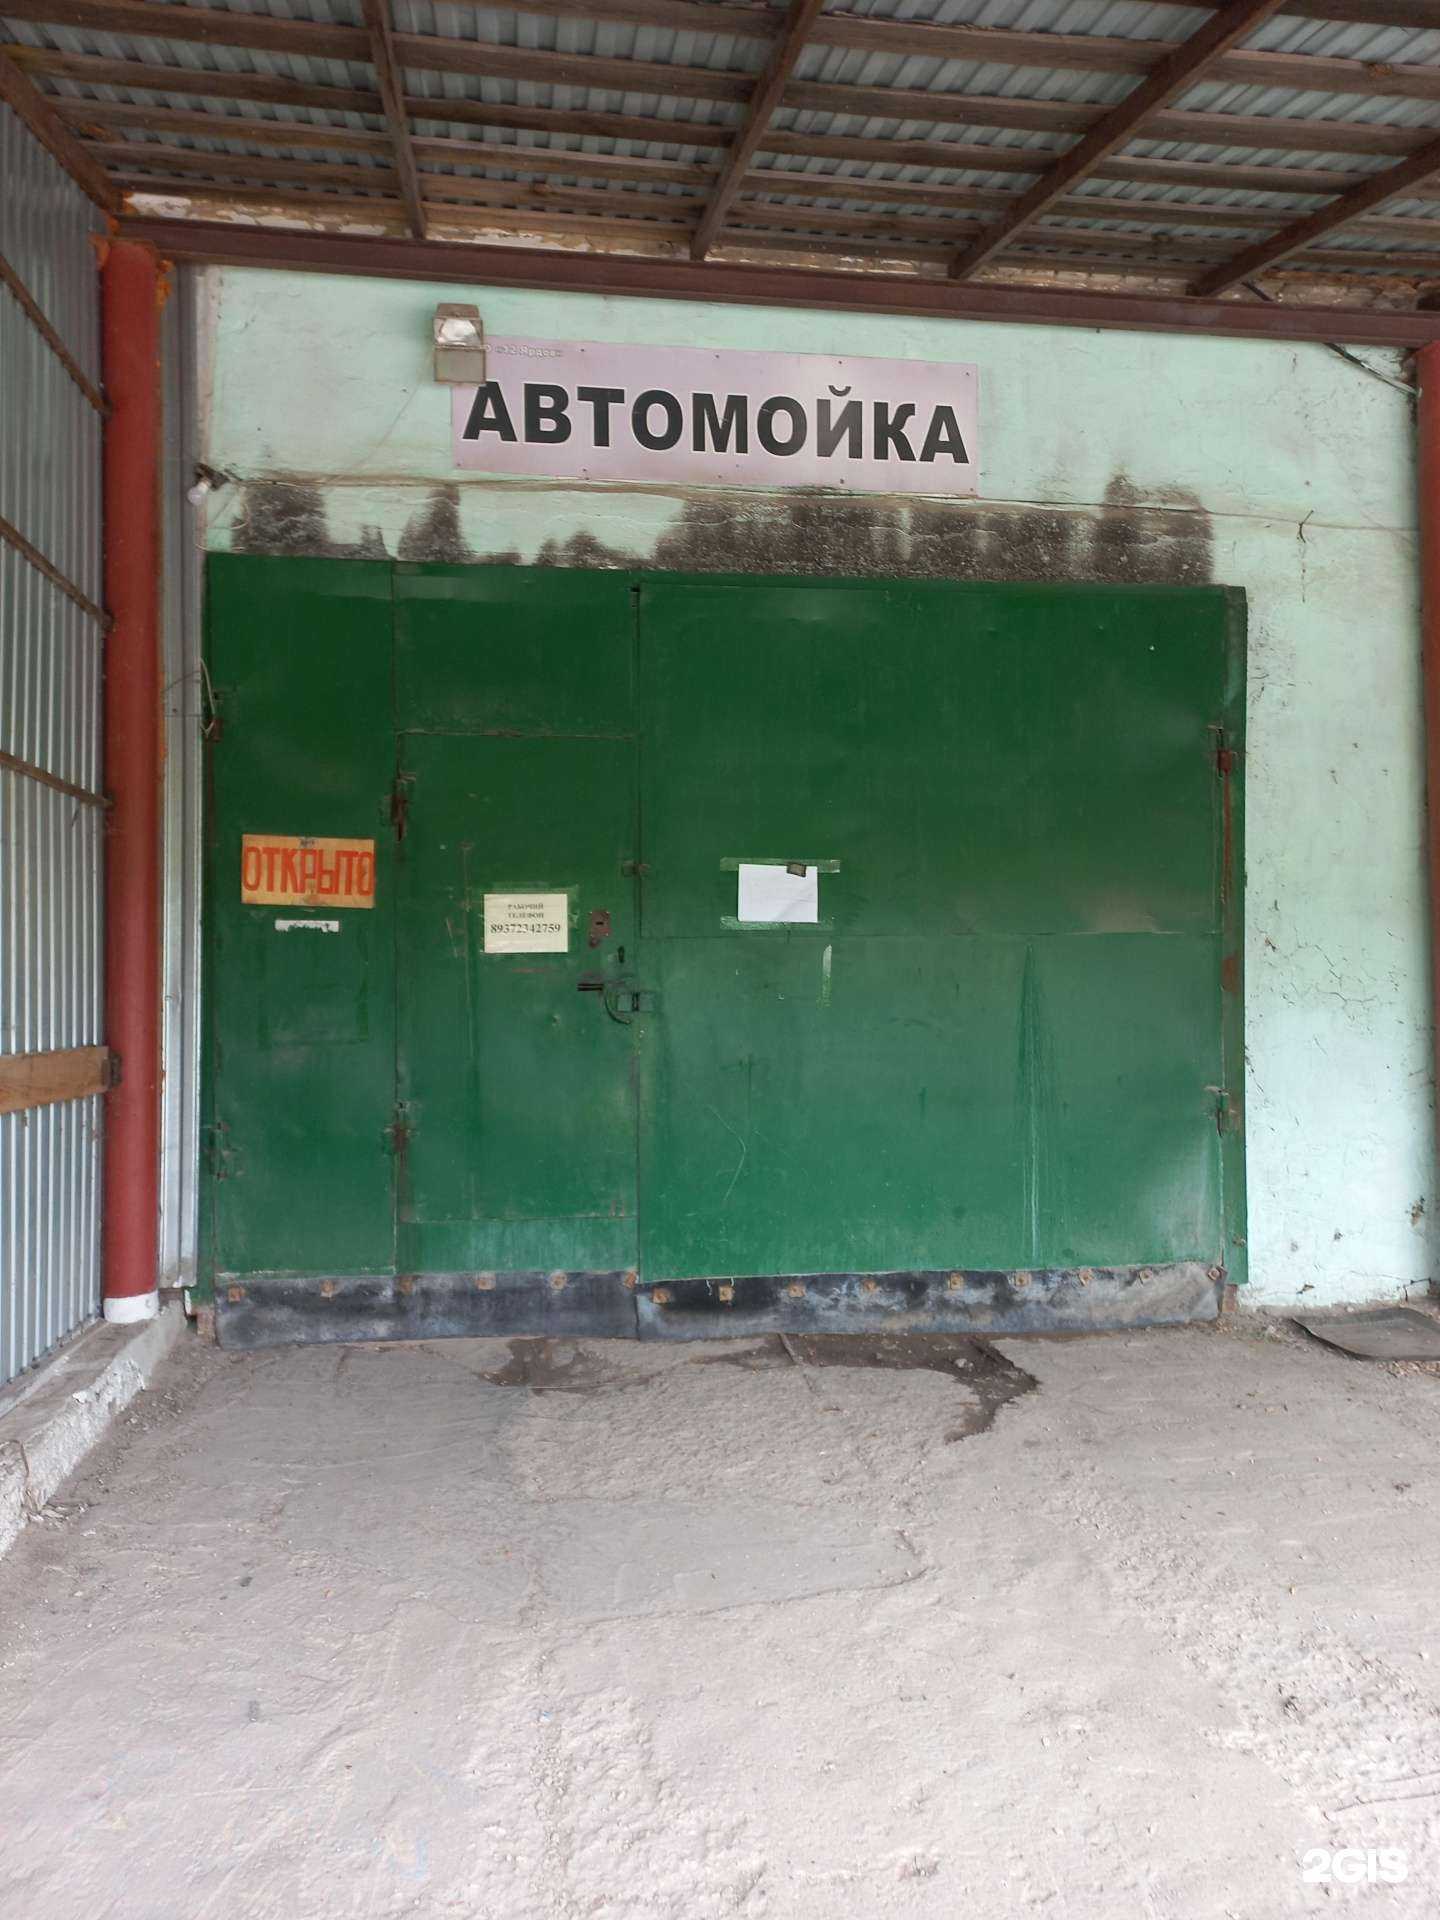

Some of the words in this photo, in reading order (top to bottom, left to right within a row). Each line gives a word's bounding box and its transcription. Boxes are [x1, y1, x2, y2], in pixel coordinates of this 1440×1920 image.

[462, 380, 970, 465] АВТОМОЙКА
[242, 846, 376, 897] ОТКРЫТО
[489, 922, 562, 935] 89372342759
[507, 911, 545, 920] ТЕЛЕФОН
